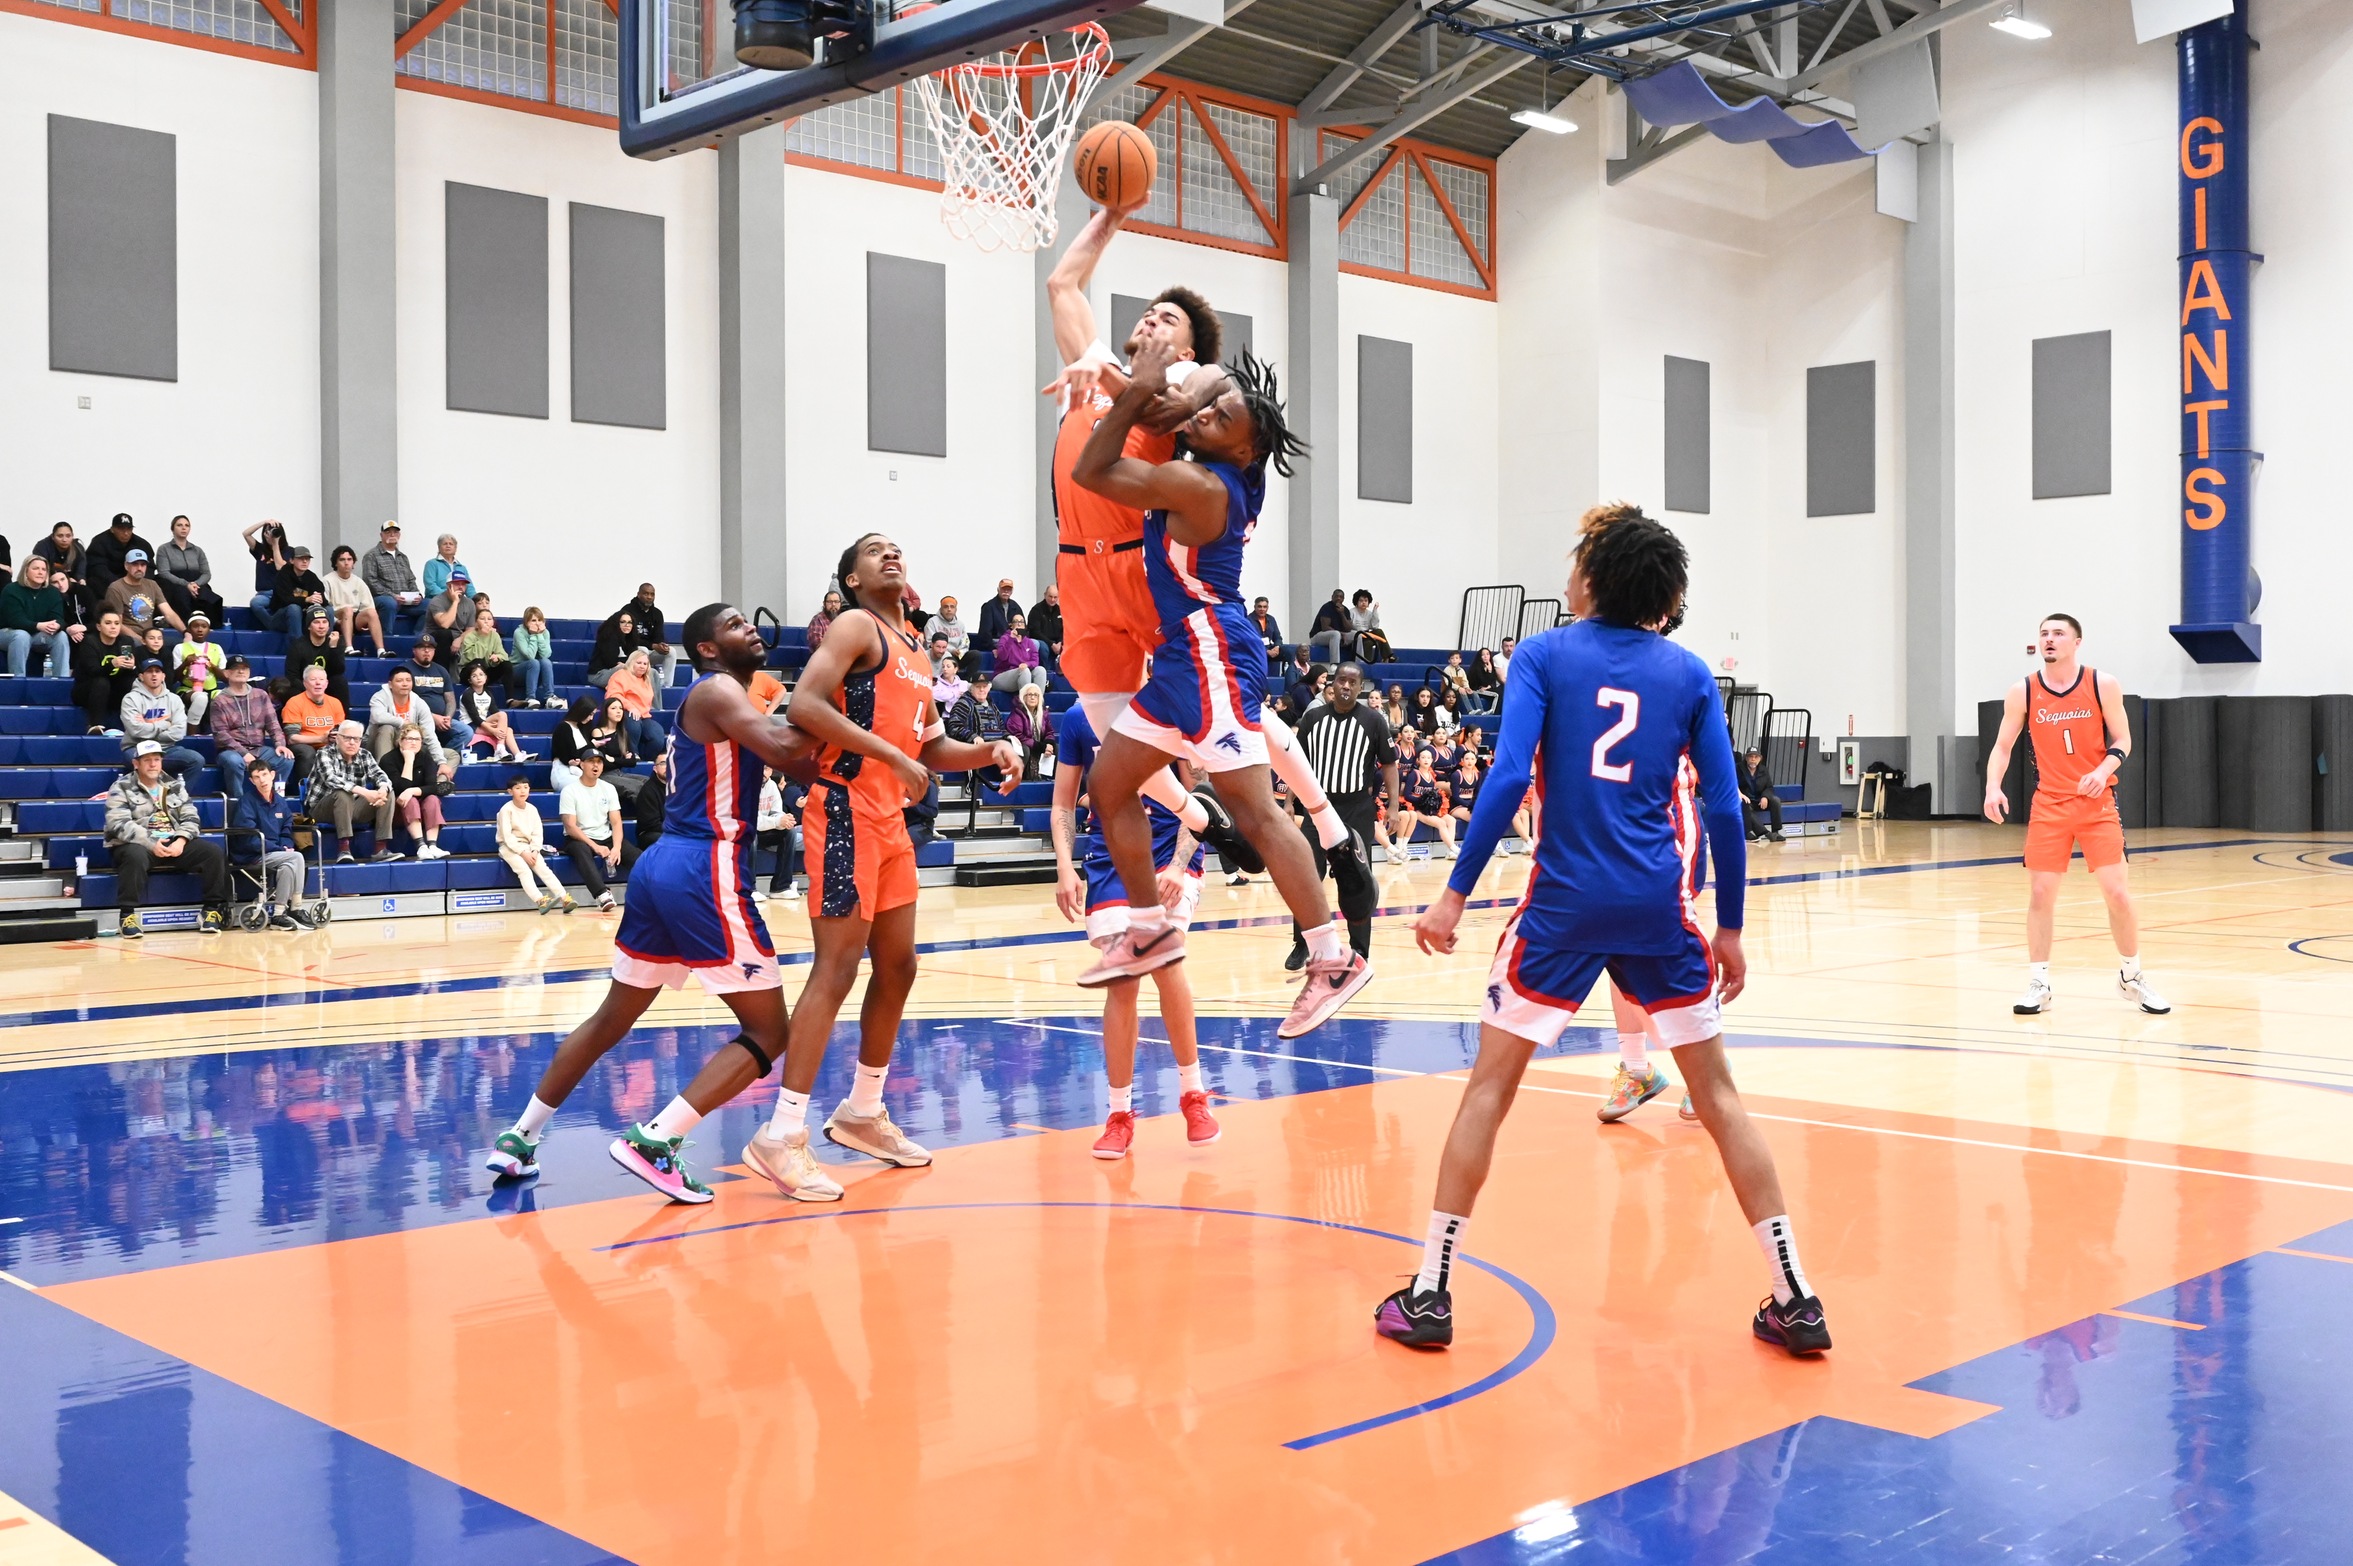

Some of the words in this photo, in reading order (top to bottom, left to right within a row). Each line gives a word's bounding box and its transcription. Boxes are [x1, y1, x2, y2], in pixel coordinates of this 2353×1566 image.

[1096, 166, 1108, 201] NCAA
[2180, 116, 2232, 532] GIANTS
[1093, 540, 1104, 554] S
[912, 699, 924, 742] 4
[2035, 707, 2093, 726] Sequoias
[1590, 687, 1640, 783] 2
[2063, 728, 2075, 755] 1
